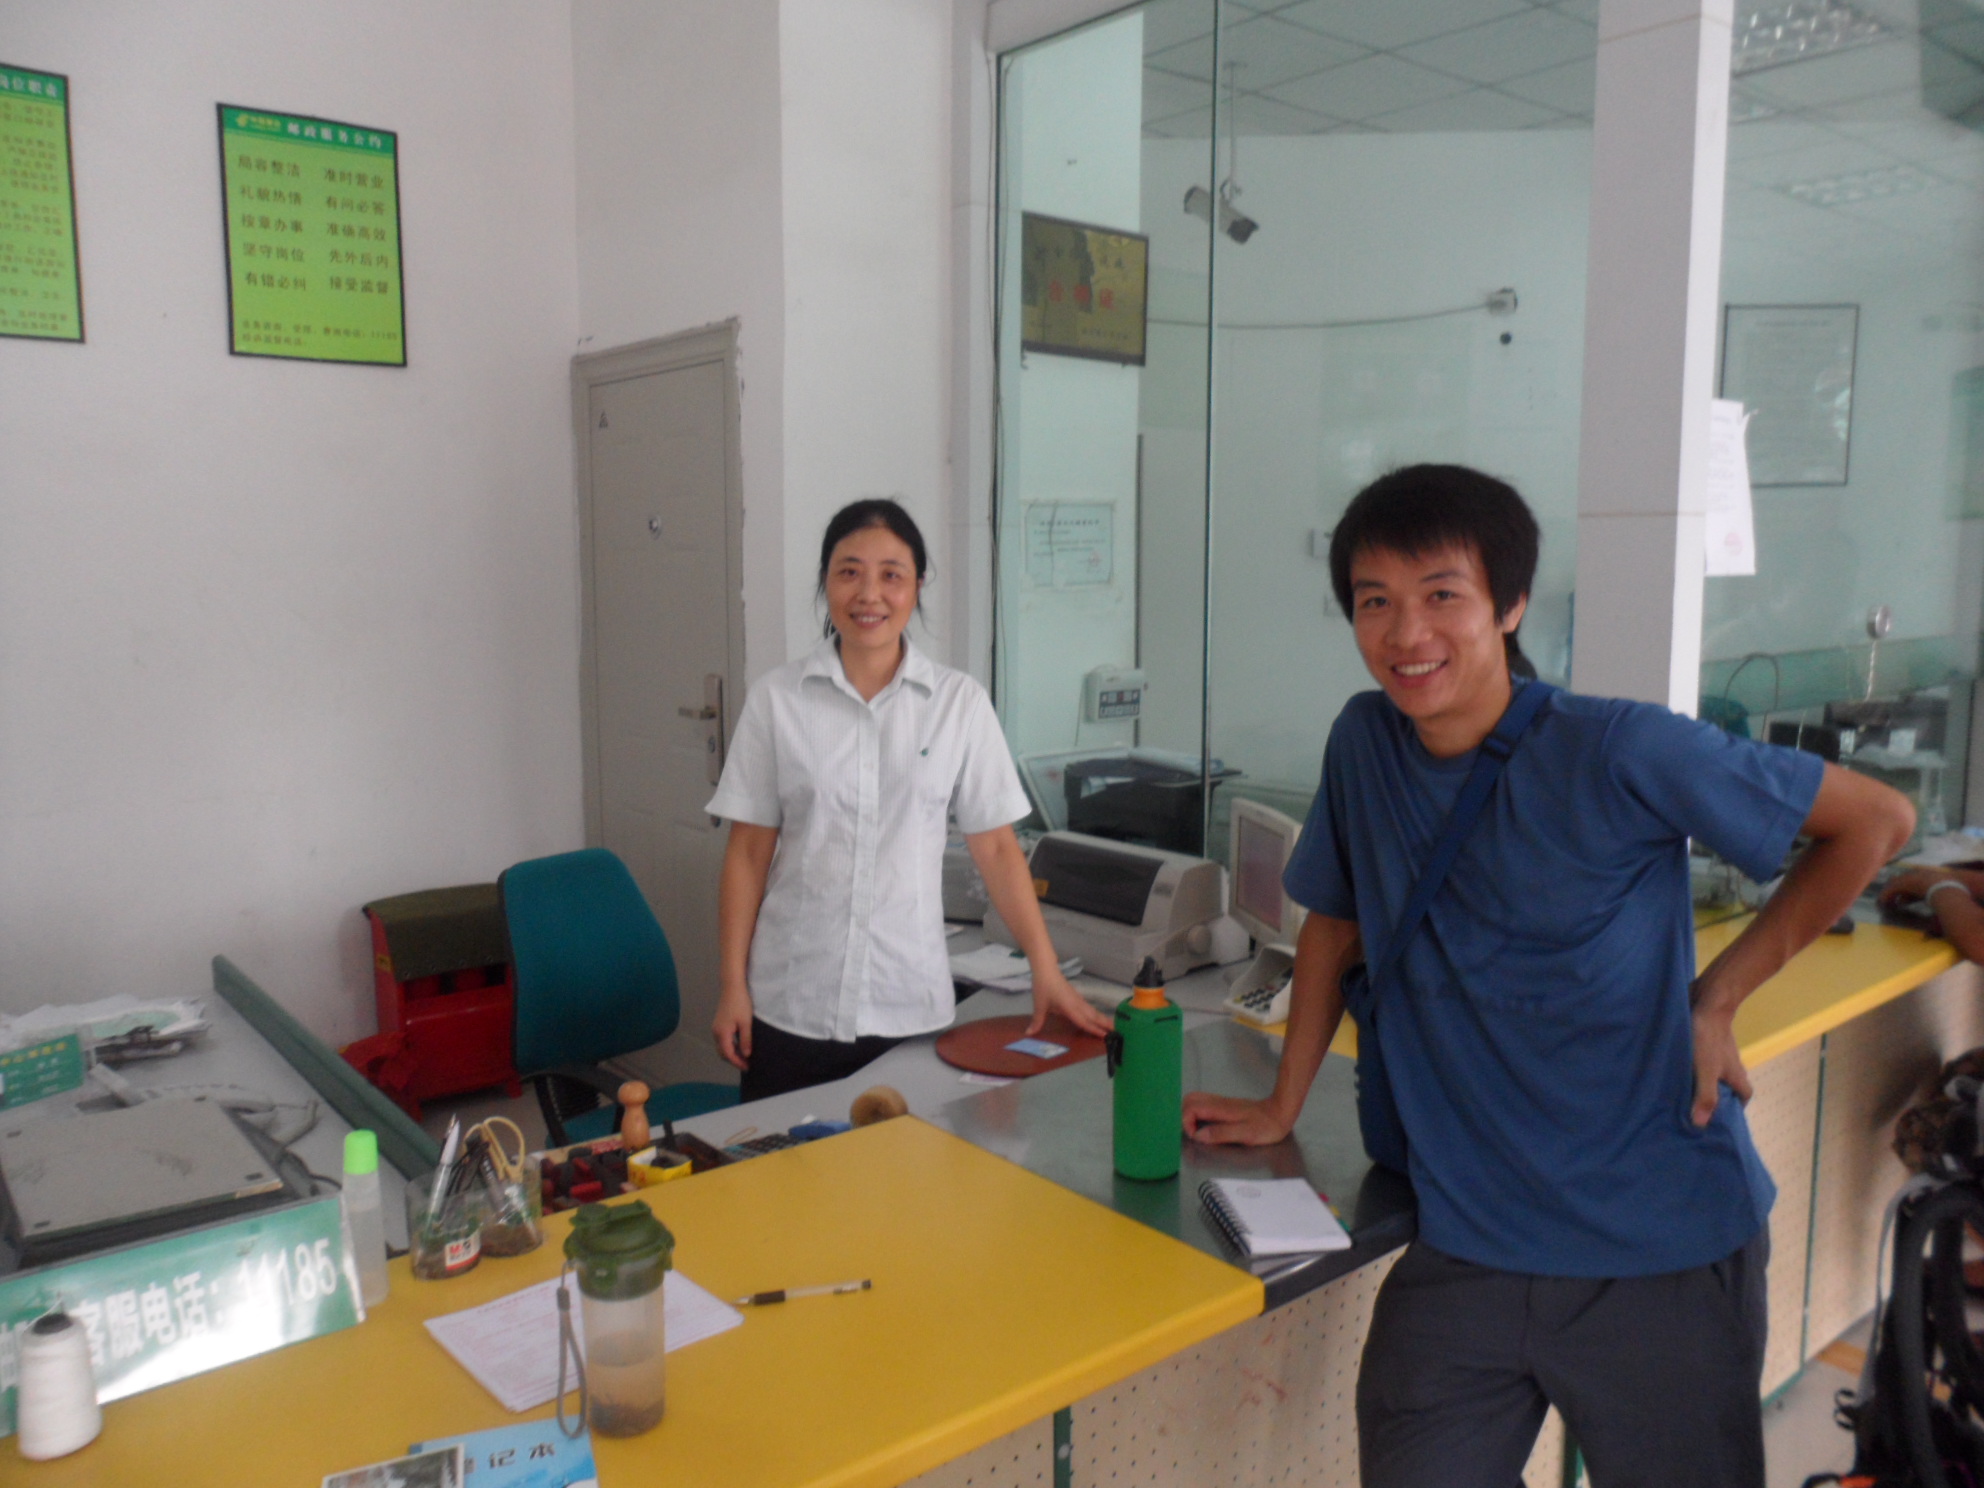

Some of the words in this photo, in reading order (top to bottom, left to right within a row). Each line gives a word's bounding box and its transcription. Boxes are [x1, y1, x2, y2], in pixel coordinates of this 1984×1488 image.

[324, 168, 384, 190] 准时营业
[241, 184, 302, 206] 礼貌热情
[326, 195, 385, 215] 有问必答
[327, 222, 386, 242] 准确高效
[243, 241, 304, 263] 坚守岗位
[330, 249, 389, 269] 先外后内
[246, 271, 306, 291] 有错必纠
[330, 275, 389, 295] 接受监督
